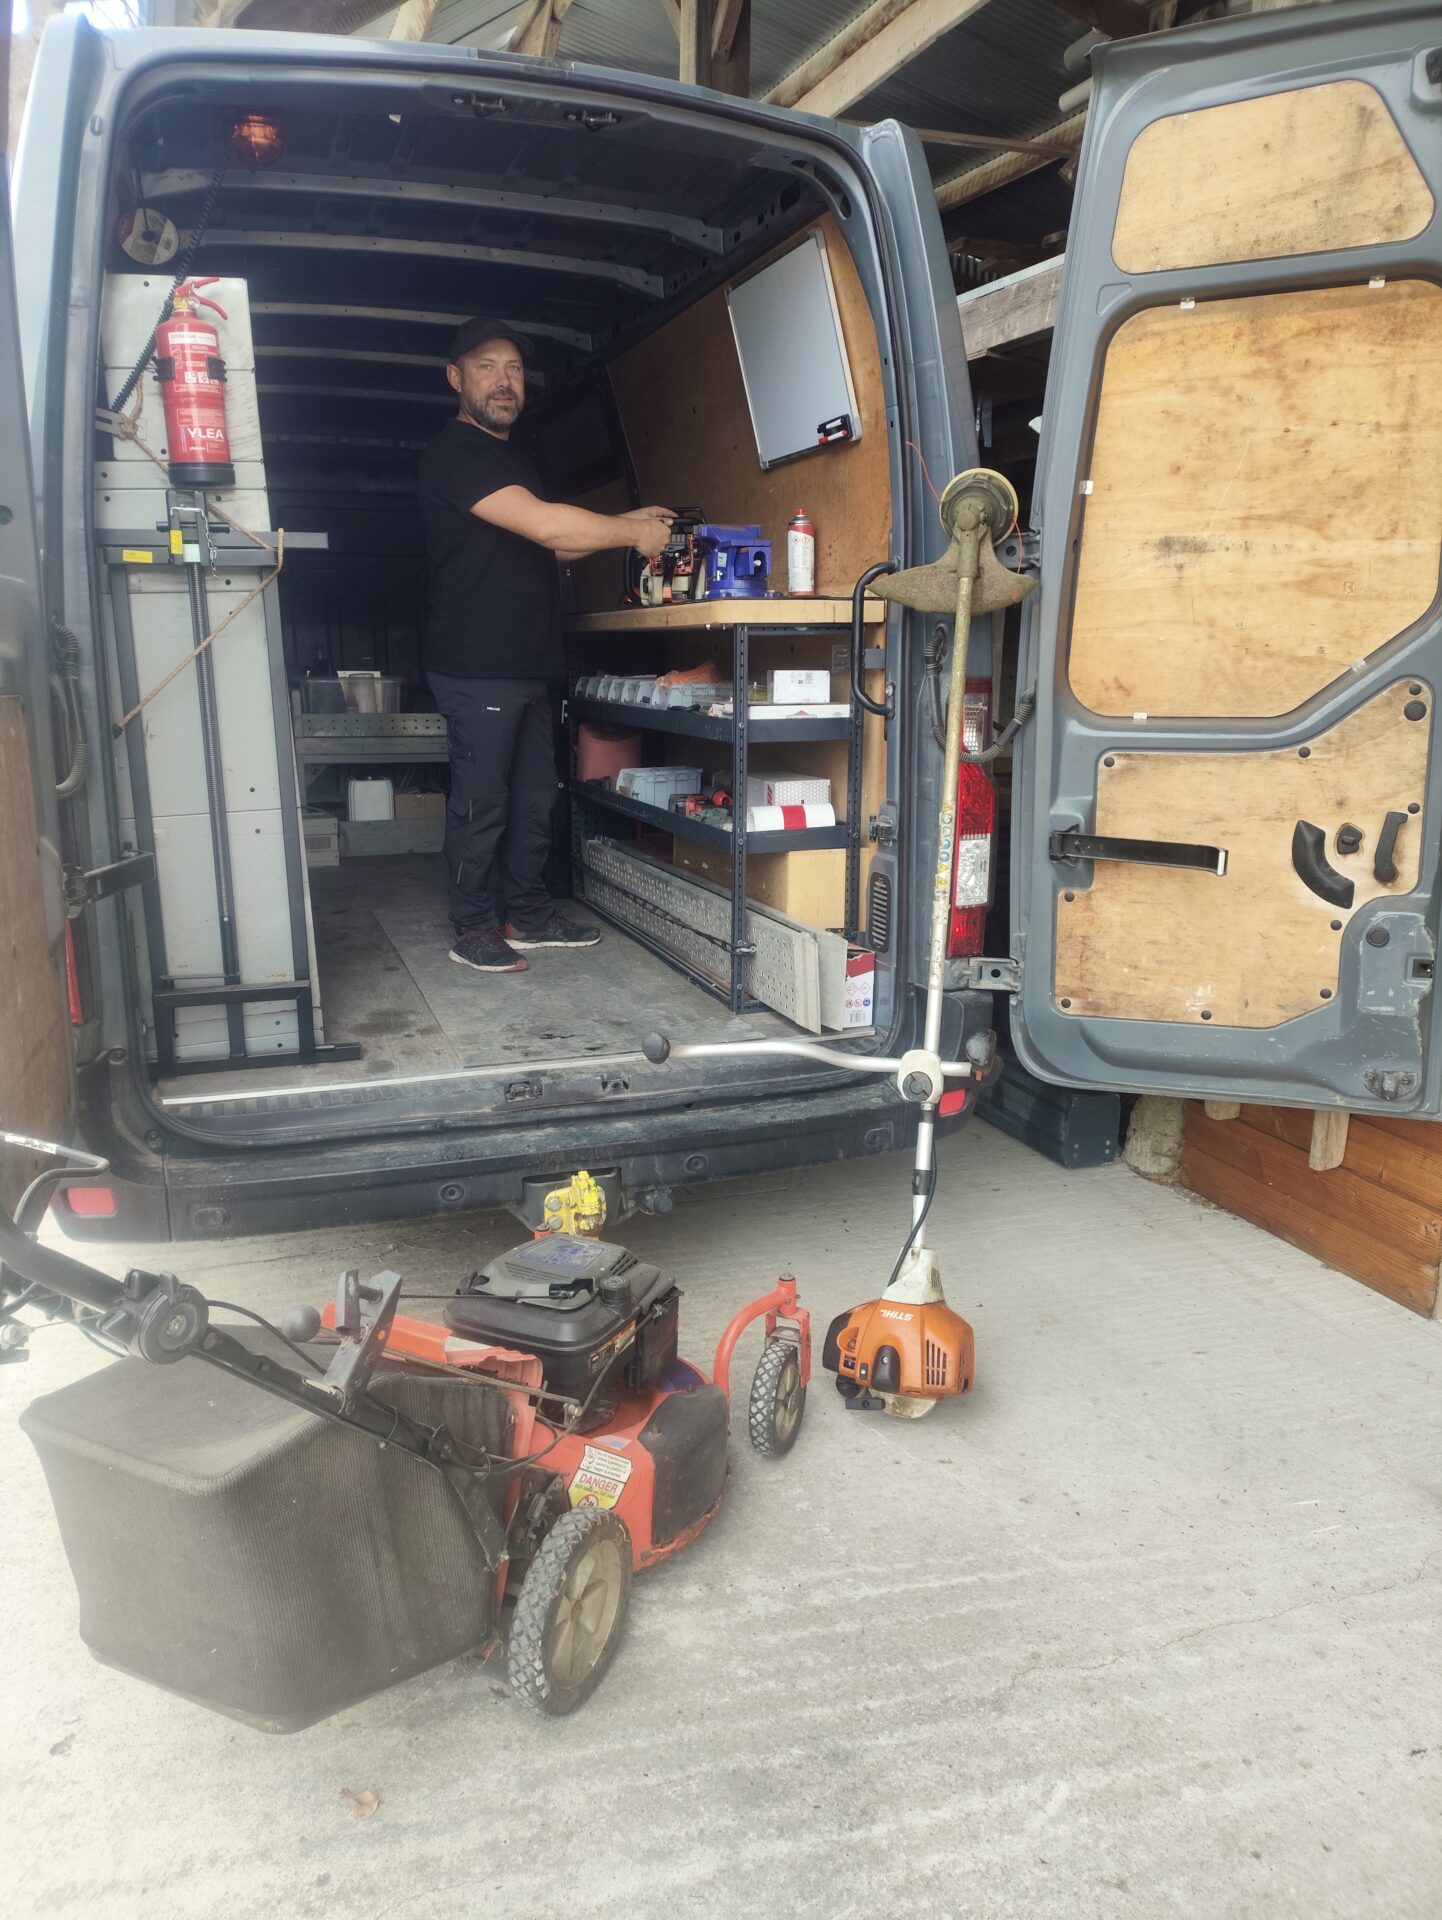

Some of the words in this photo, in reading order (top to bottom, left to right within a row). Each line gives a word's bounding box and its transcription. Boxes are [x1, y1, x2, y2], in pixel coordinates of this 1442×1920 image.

[187, 427, 224, 440] YLEA
[880, 1309, 914, 1321] STIHL
[579, 1473, 619, 1493] DANGER
